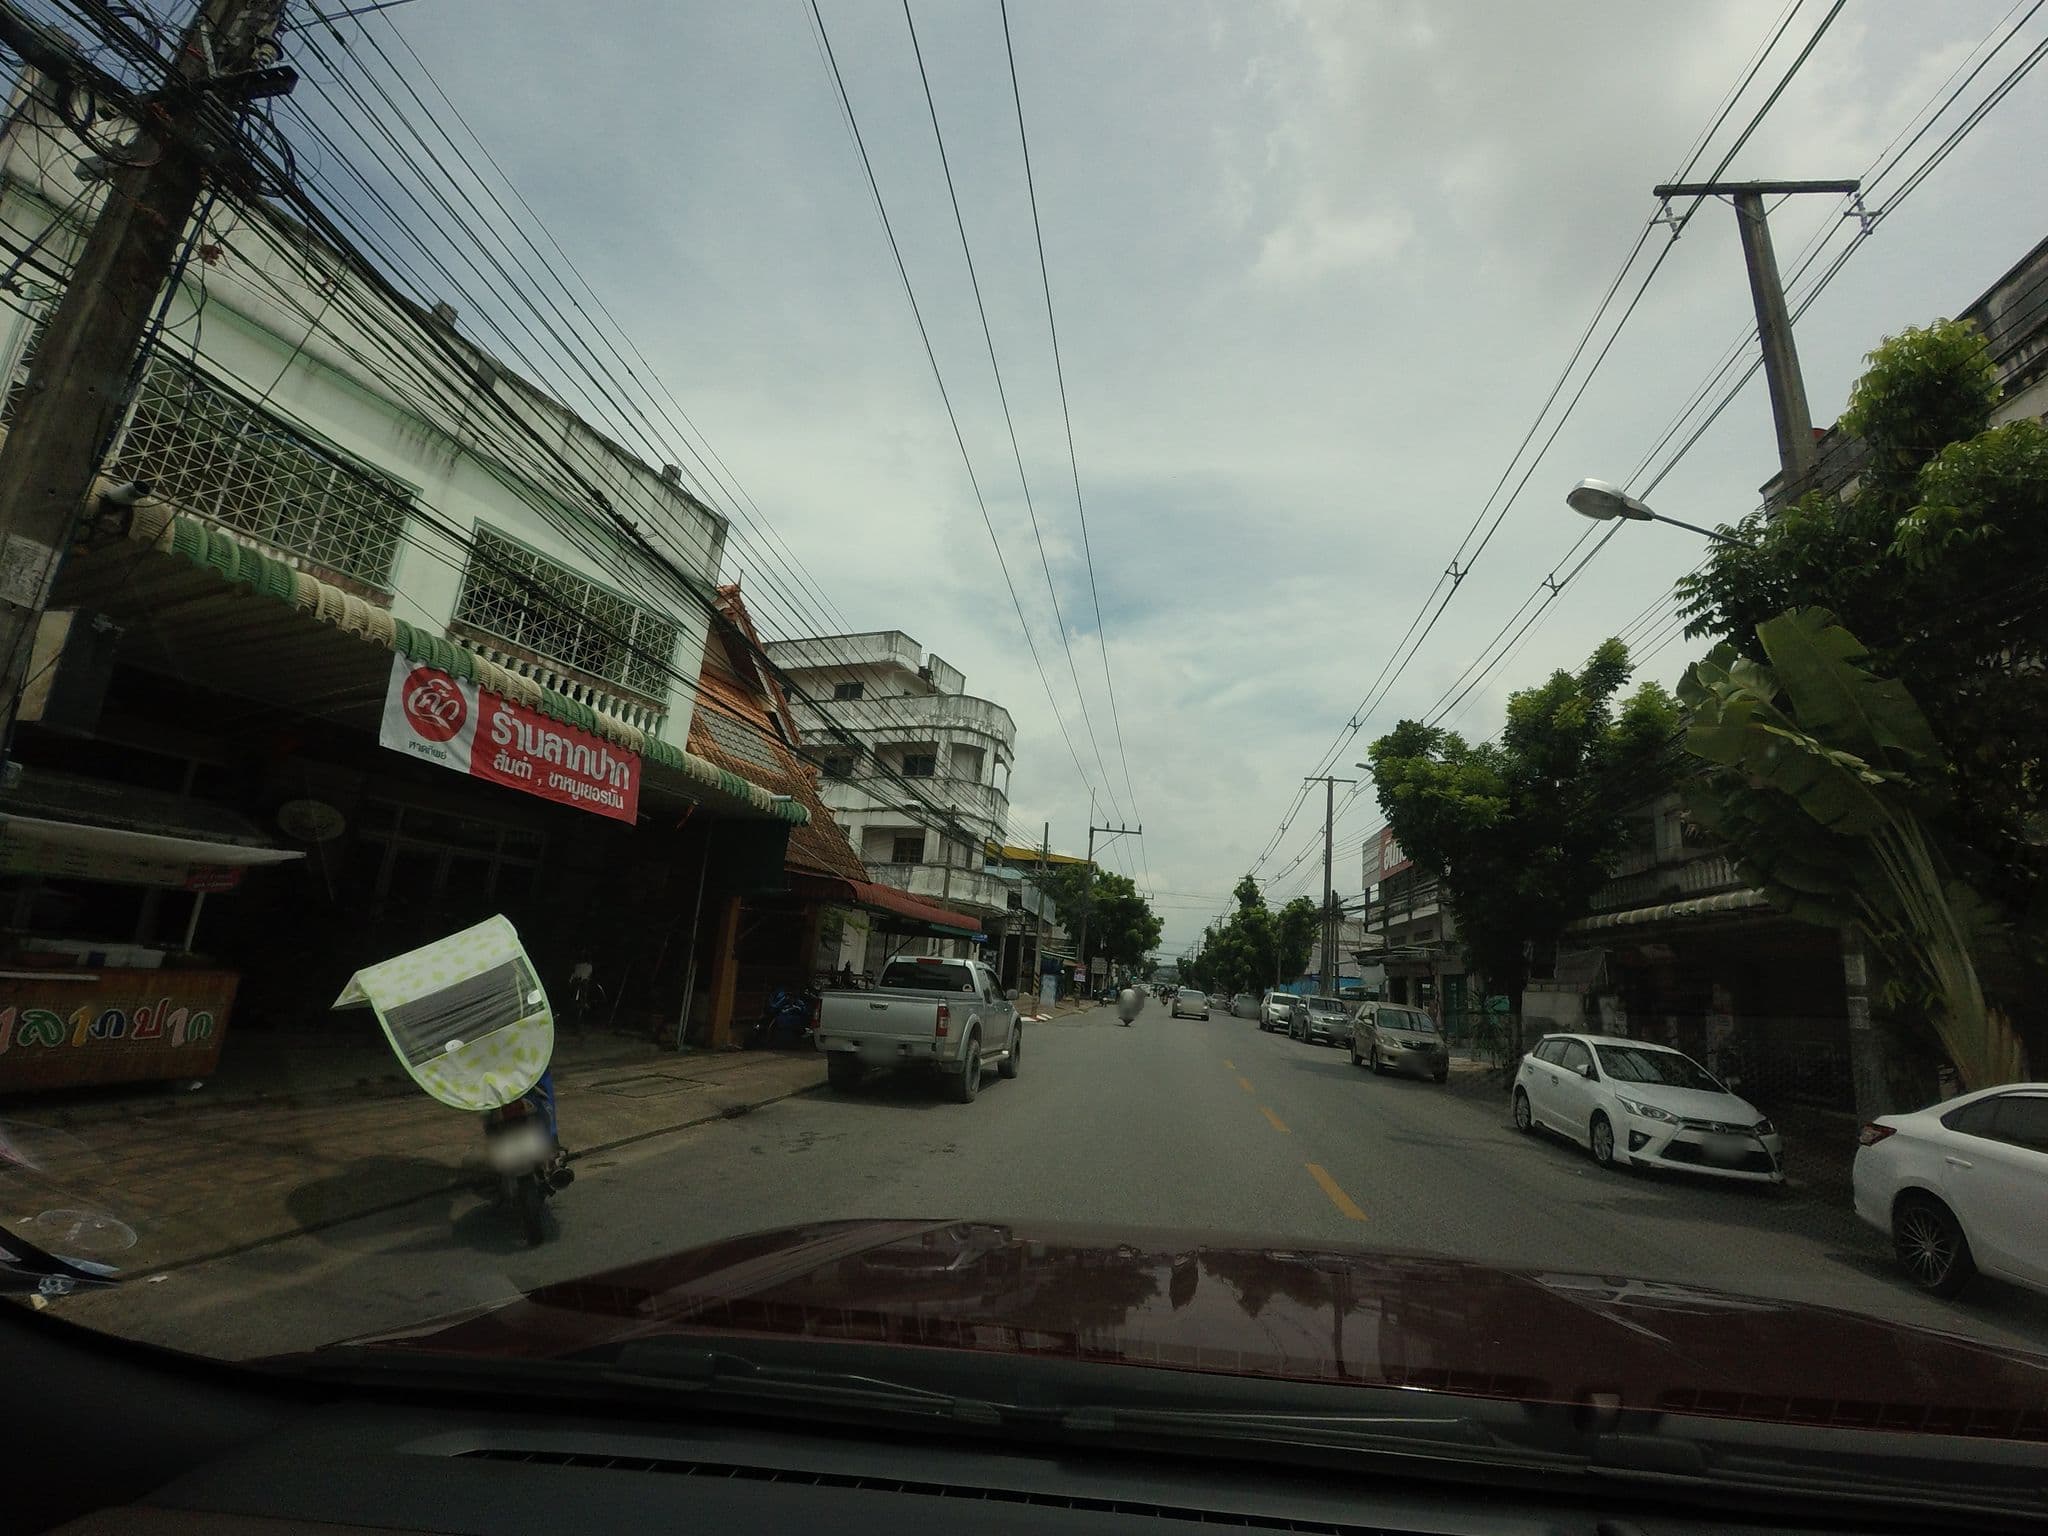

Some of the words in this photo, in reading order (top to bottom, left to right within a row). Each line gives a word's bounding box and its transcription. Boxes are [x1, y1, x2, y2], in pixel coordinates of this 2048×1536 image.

[490, 701, 631, 790] ร้านลากปาก
[492, 748, 533, 780] ส้มตำ
[548, 771, 624, 810] ขาหมูเยอรมัน
